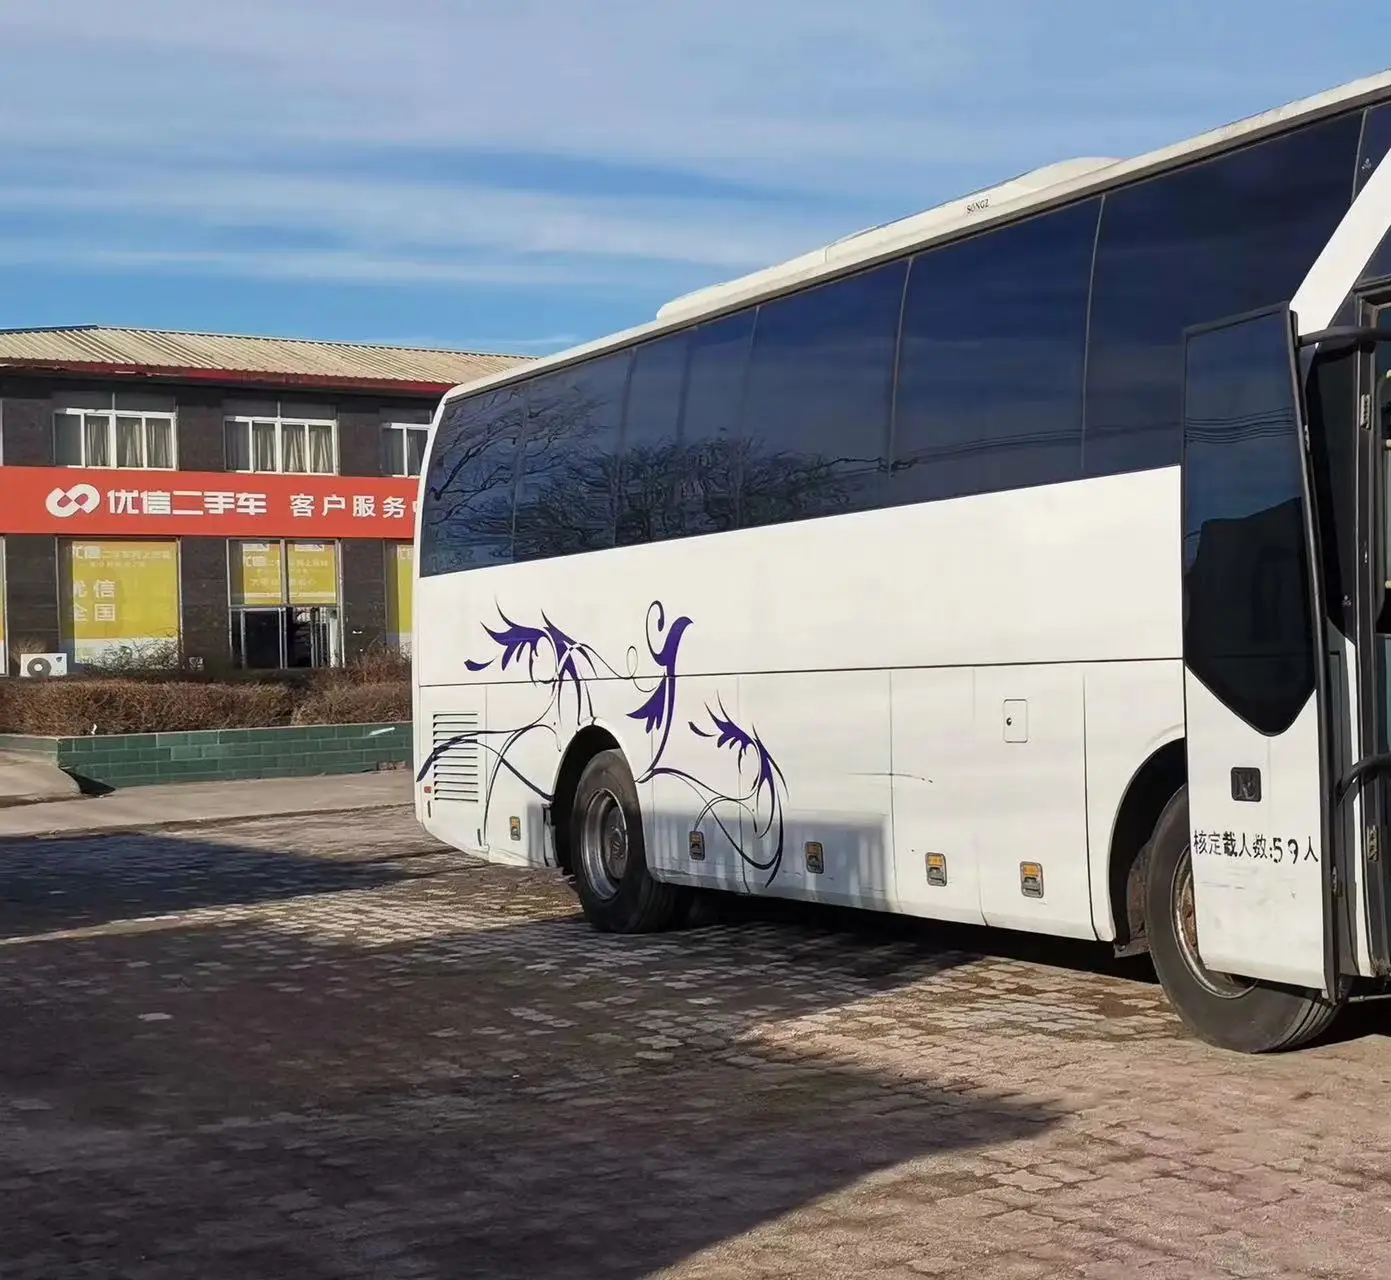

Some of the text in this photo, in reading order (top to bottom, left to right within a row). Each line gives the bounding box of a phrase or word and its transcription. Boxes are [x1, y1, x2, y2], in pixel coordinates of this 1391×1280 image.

[107, 489, 268, 516] 优信二手车
